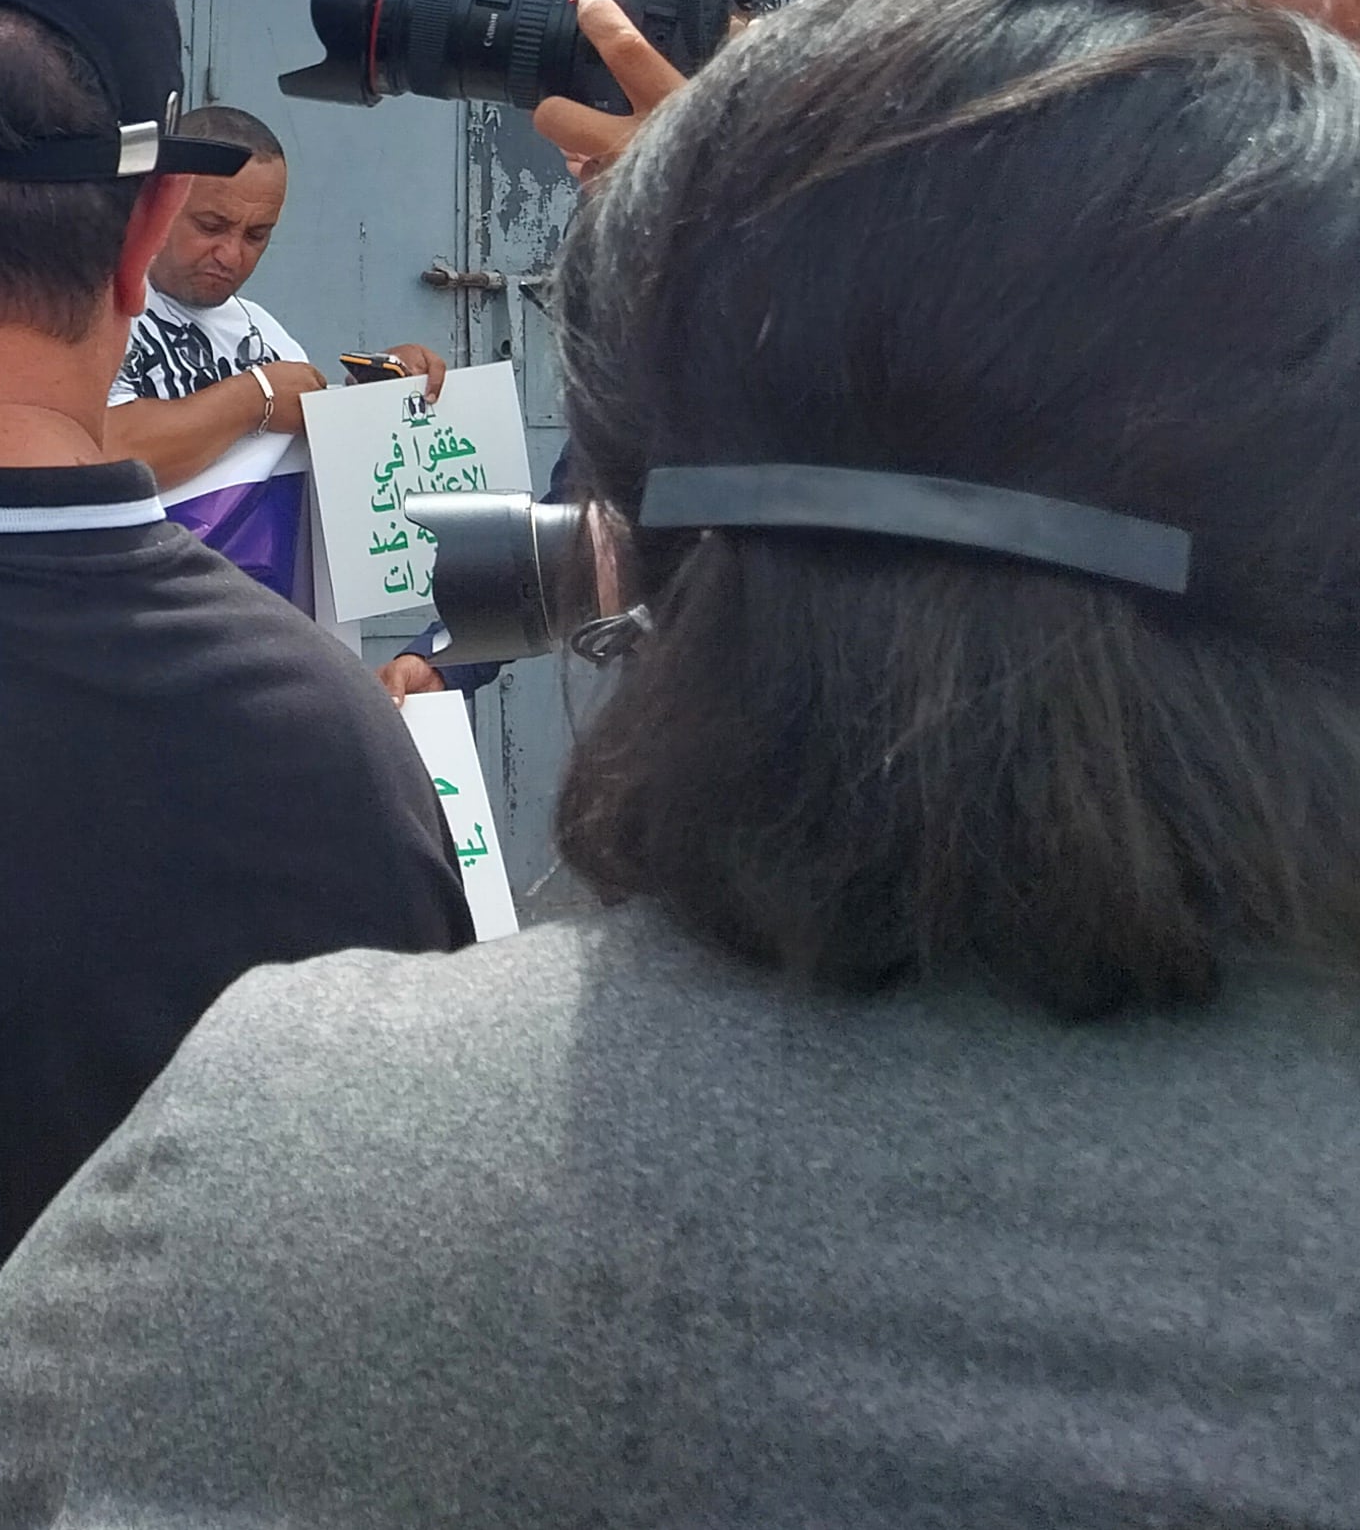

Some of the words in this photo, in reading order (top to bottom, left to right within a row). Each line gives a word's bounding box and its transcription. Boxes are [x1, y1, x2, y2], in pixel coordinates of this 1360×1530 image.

[374, 433, 405, 483] في
[412, 427, 477, 474] حققوا
[368, 521, 409, 556] ضد
